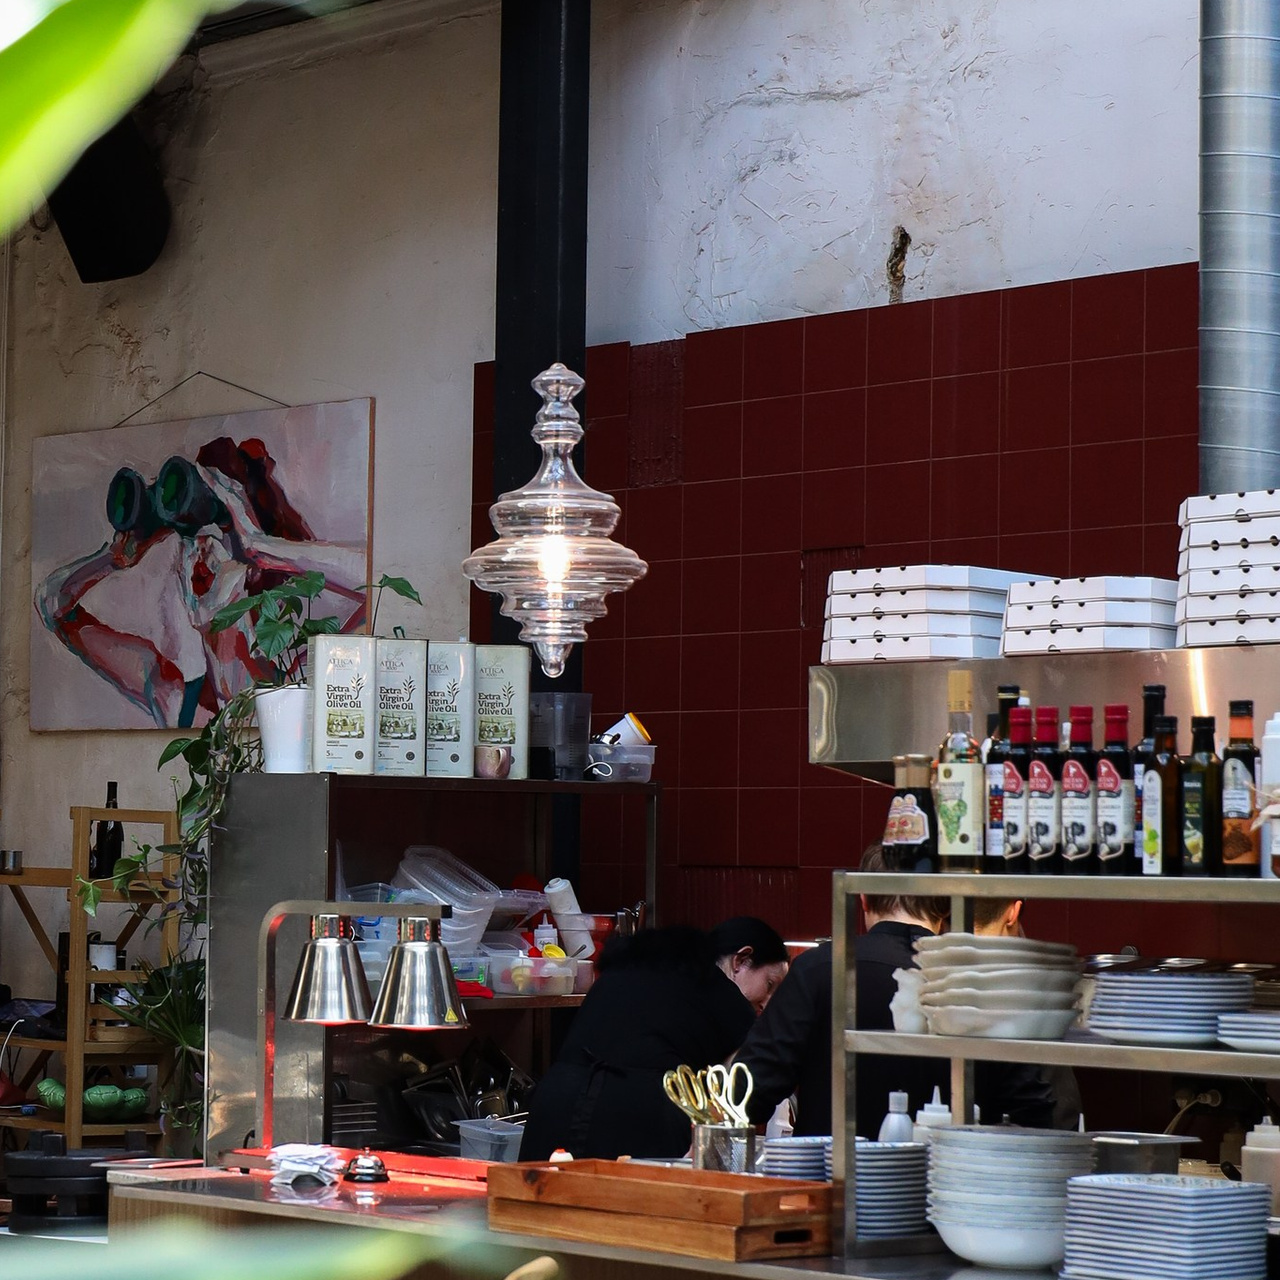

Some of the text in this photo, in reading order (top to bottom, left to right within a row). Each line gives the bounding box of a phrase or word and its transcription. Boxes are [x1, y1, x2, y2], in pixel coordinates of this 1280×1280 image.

[326, 684, 350, 692] Extra
[379, 686, 402, 694] Extra
[326, 692, 352, 702] Virgin
[379, 694, 405, 704] Virgin
[478, 692, 501, 700] Extra
[326, 700, 362, 709] Olive Oil
[379, 702, 414, 711] Olive Oil
[428, 697, 449, 707] irgin
[478, 700, 504, 709] Virgin
[428, 704, 457, 713] live Oil
[500, 708, 513, 716] Oil
